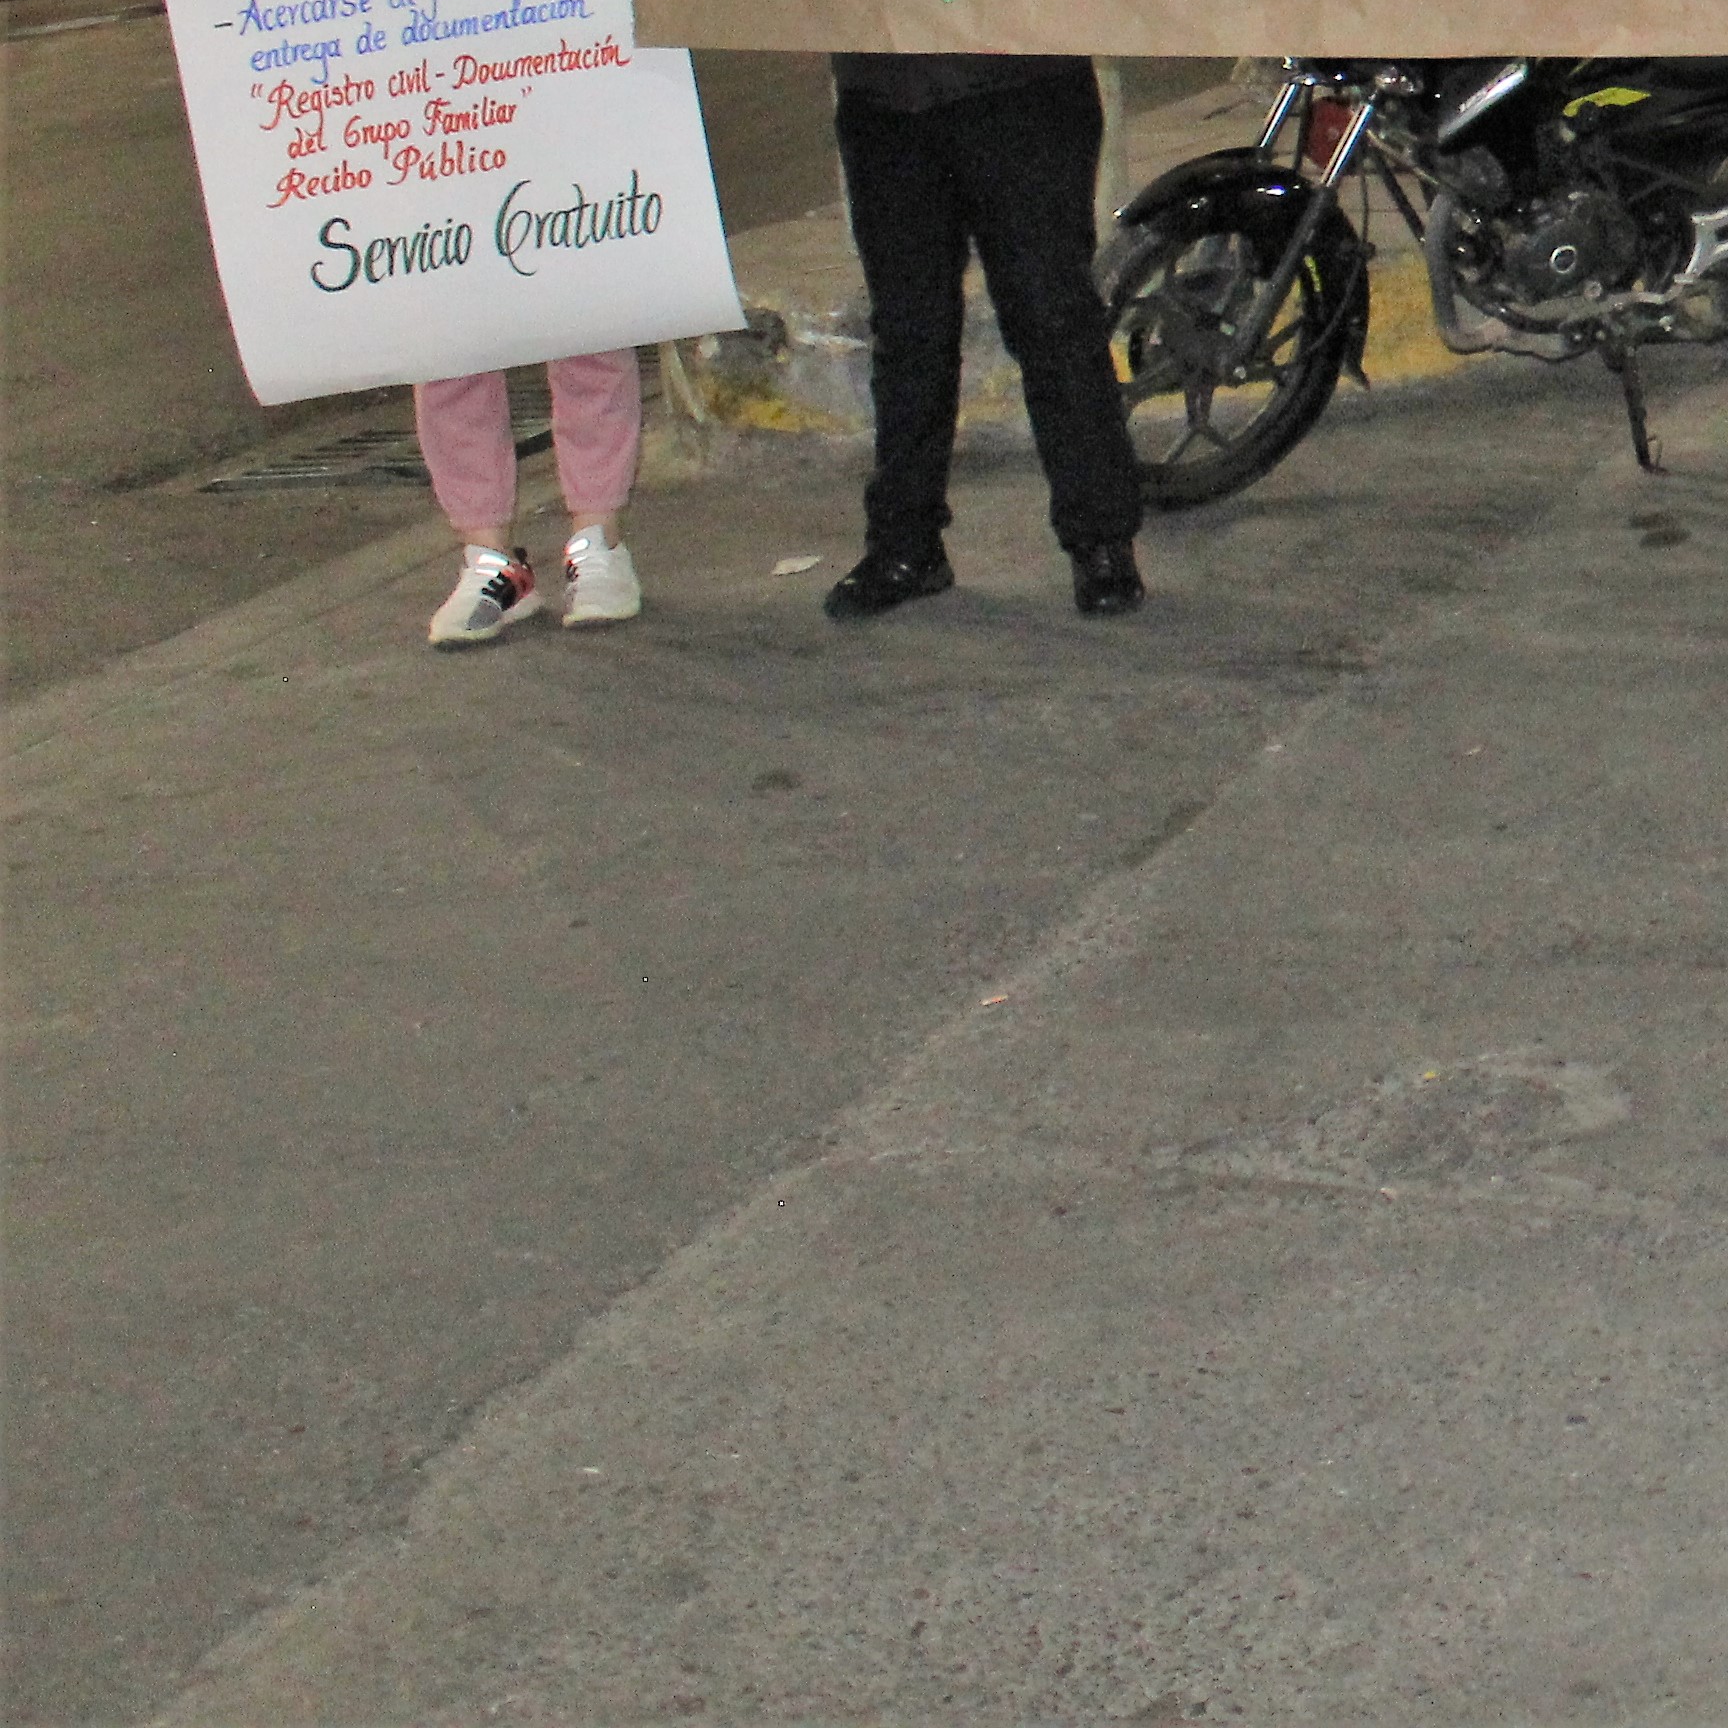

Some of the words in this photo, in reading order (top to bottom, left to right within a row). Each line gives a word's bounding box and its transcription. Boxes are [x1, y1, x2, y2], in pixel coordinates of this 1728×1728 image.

[250, 32, 342, 83] entrega
[357, 23, 386, 54] de
[388, 66, 430, 99] civil
[455, 36, 630, 87] Documentación
[287, 123, 326, 161] del
[345, 116, 411, 163] Grupo
[267, 166, 371, 209] Recibo
[388, 145, 507, 188] Público
[311, 216, 472, 293] Servicio
[496, 170, 662, 276] Gratuito
